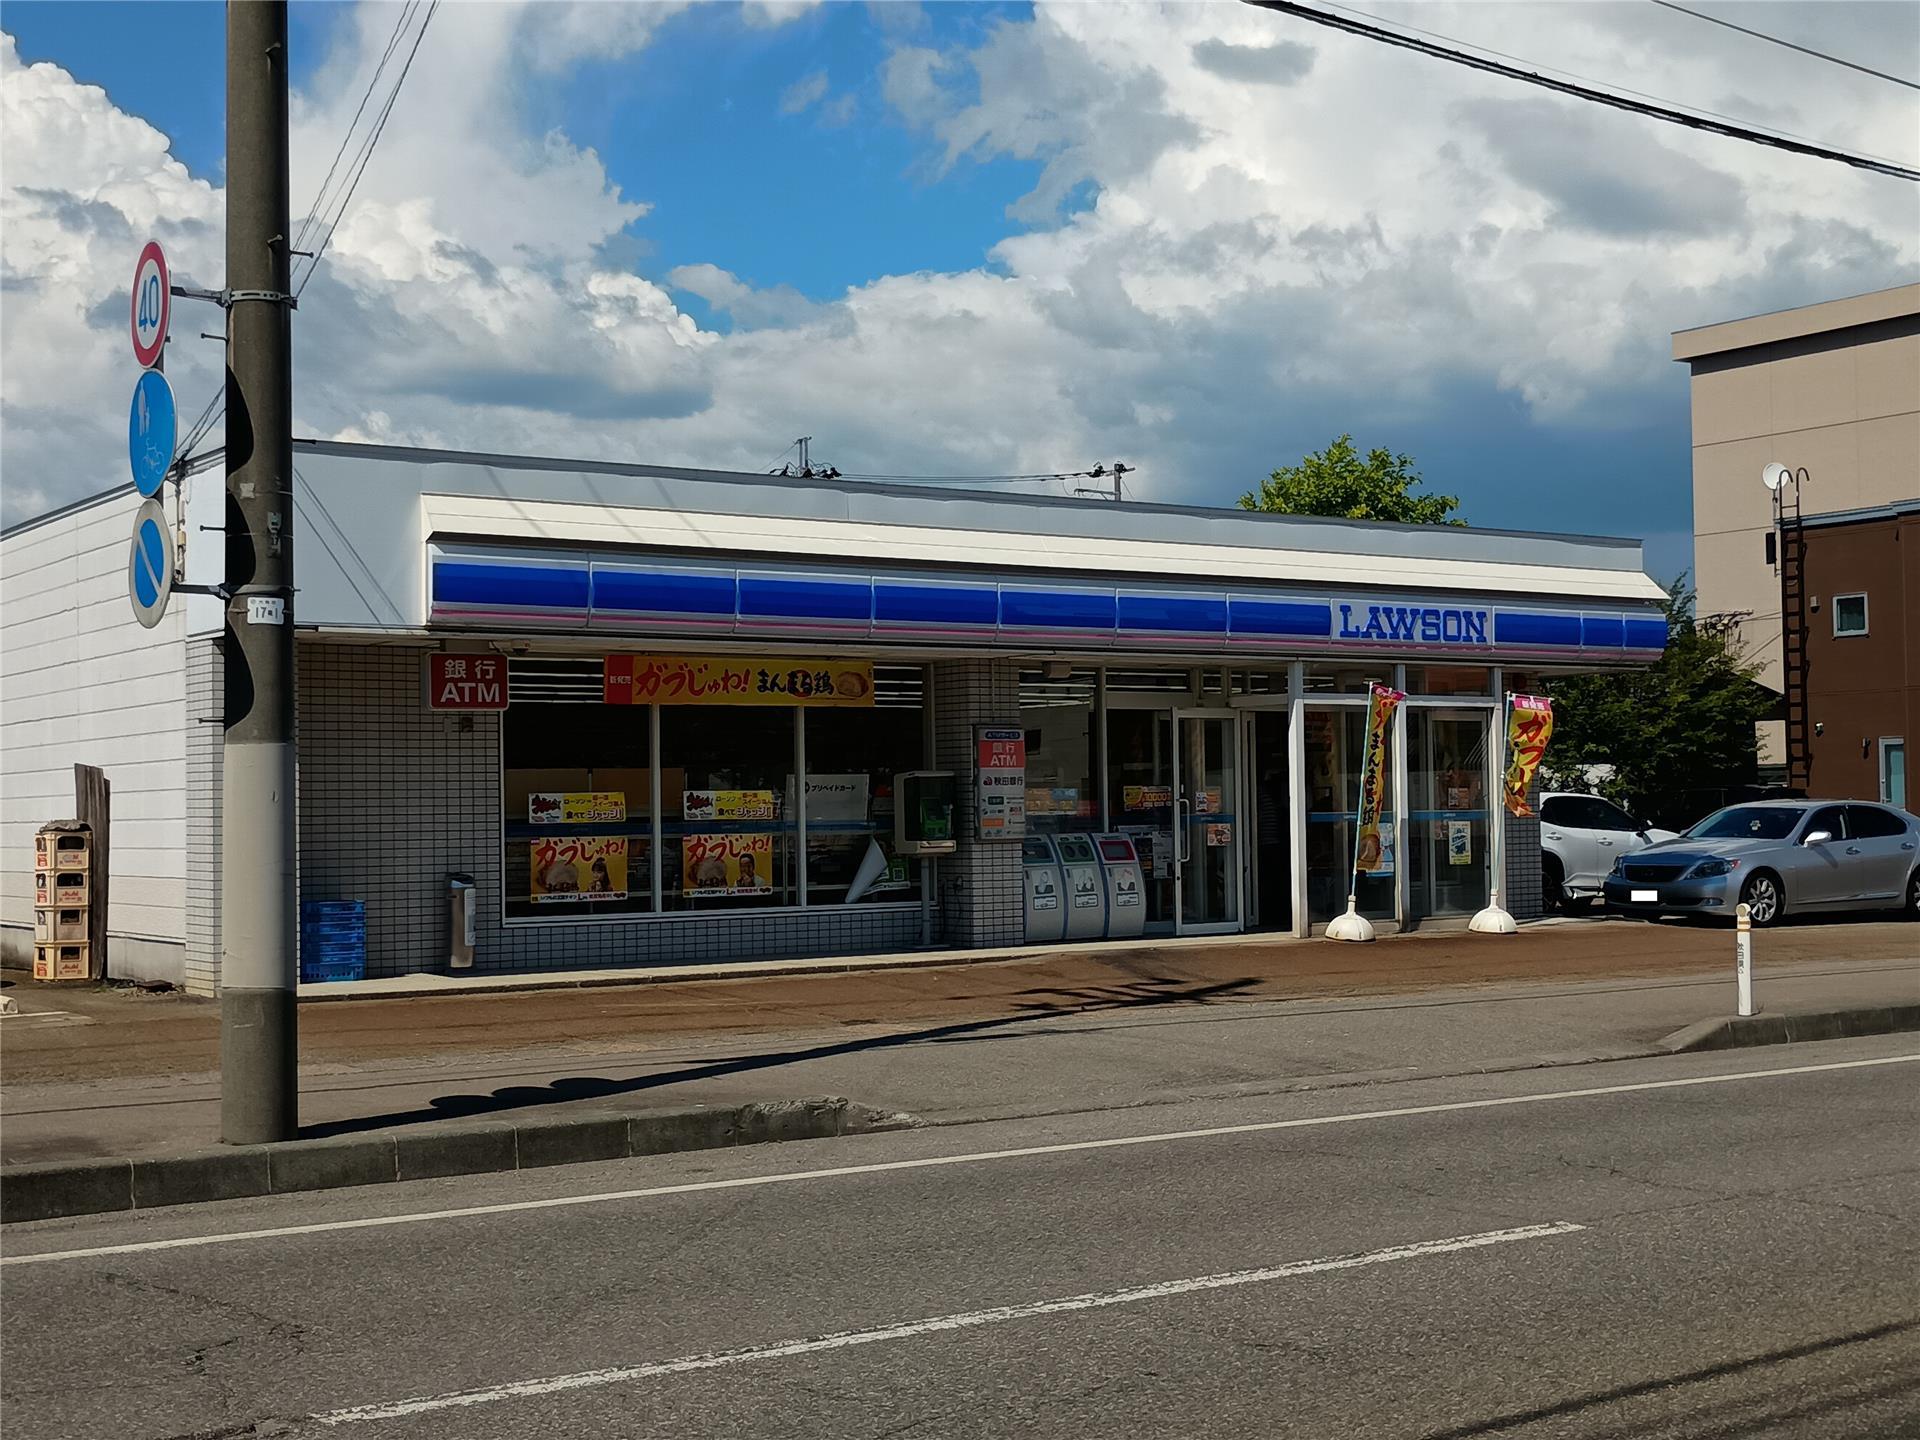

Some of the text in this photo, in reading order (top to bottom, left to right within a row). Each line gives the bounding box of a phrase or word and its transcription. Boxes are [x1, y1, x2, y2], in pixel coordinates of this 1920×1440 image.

[138, 275, 159, 332] 40
[1338, 604, 1487, 643] LAWSON
[444, 659, 496, 679] 銀行
[440, 682, 500, 703] ATM
[990, 754, 1017, 767] ATM
